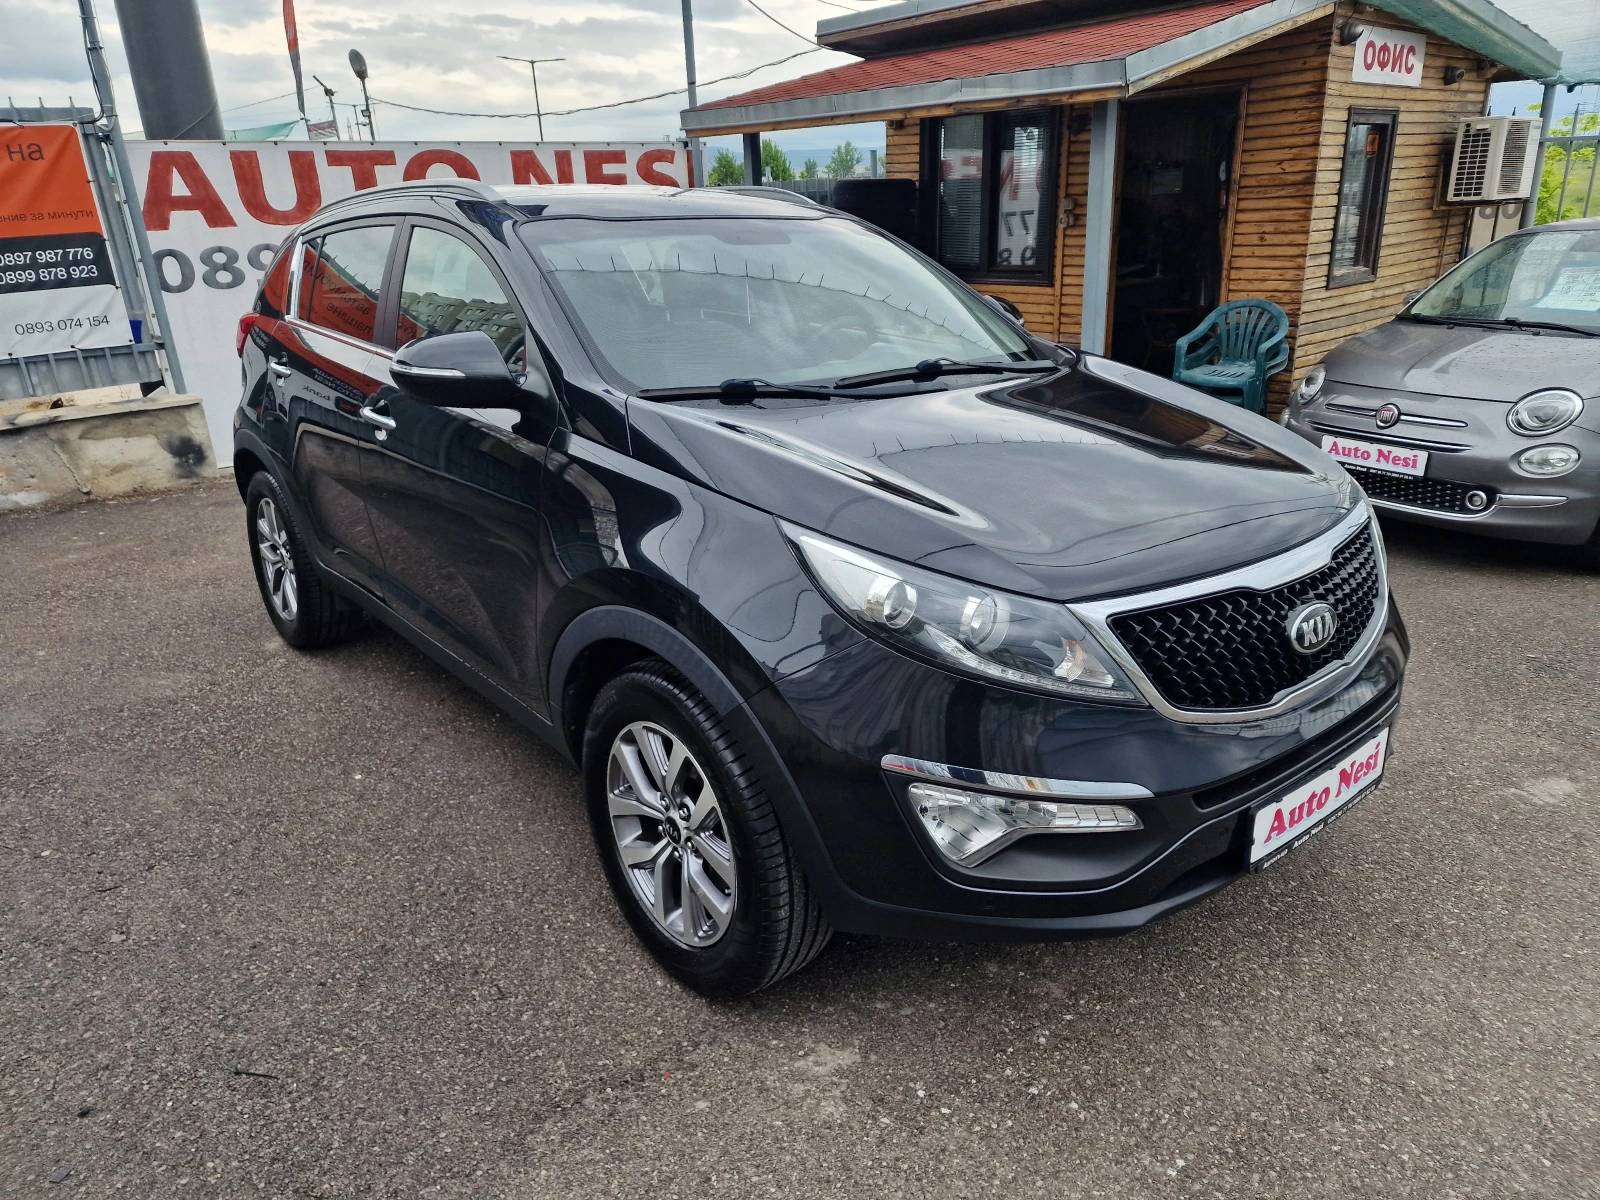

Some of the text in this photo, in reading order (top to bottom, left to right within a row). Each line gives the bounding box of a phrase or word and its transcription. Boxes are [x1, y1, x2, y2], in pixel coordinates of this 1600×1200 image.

[1363, 40, 1417, 75] ОФИС
[6, 143, 45, 162] на
[142, 148, 481, 231] AUTO
[30, 212, 44, 220] за
[48, 210, 94, 219] минути
[35, 249, 63, 263] 987
[65, 247, 94, 260] 776
[39, 267, 67, 281] 878
[69, 264, 98, 278] 923
[14, 314, 110, 336] 0893 074 154
[1380, 410, 1397, 423] FIAT
[1328, 440, 1419, 469] Auto Nesi
[1301, 612, 1334, 646] KIA
[1263, 786, 1331, 844] Auto
[1335, 741, 1381, 798] Nesi
